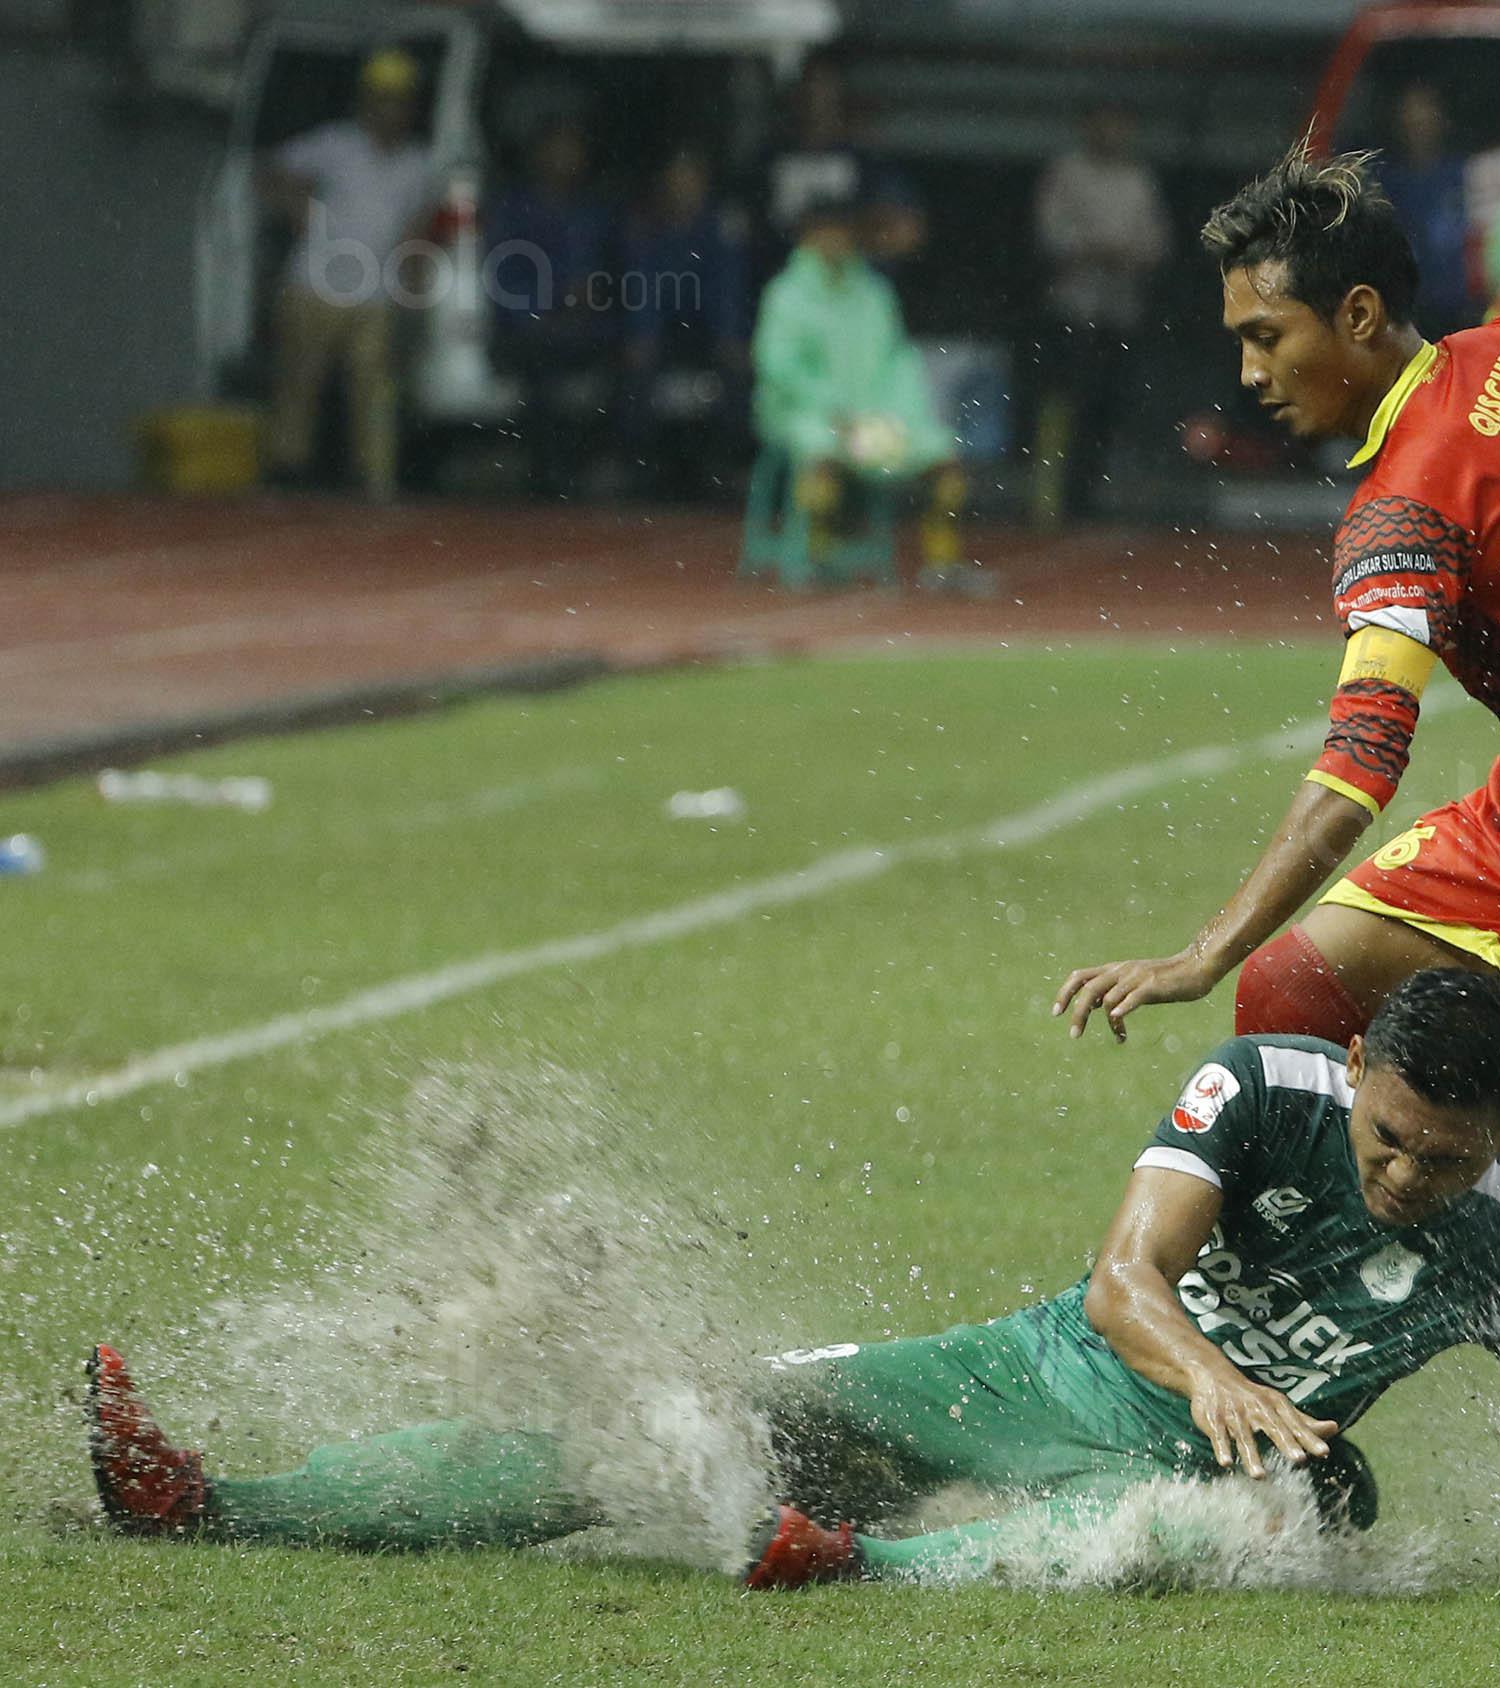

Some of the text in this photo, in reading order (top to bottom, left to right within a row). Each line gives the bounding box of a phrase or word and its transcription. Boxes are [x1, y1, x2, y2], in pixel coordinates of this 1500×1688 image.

[1352, 555, 1382, 580] LASKAR
[1381, 552, 1414, 571] SULTAN
[1261, 1210, 1290, 1233] SPORT
[1265, 1300, 1374, 1377] JEK
